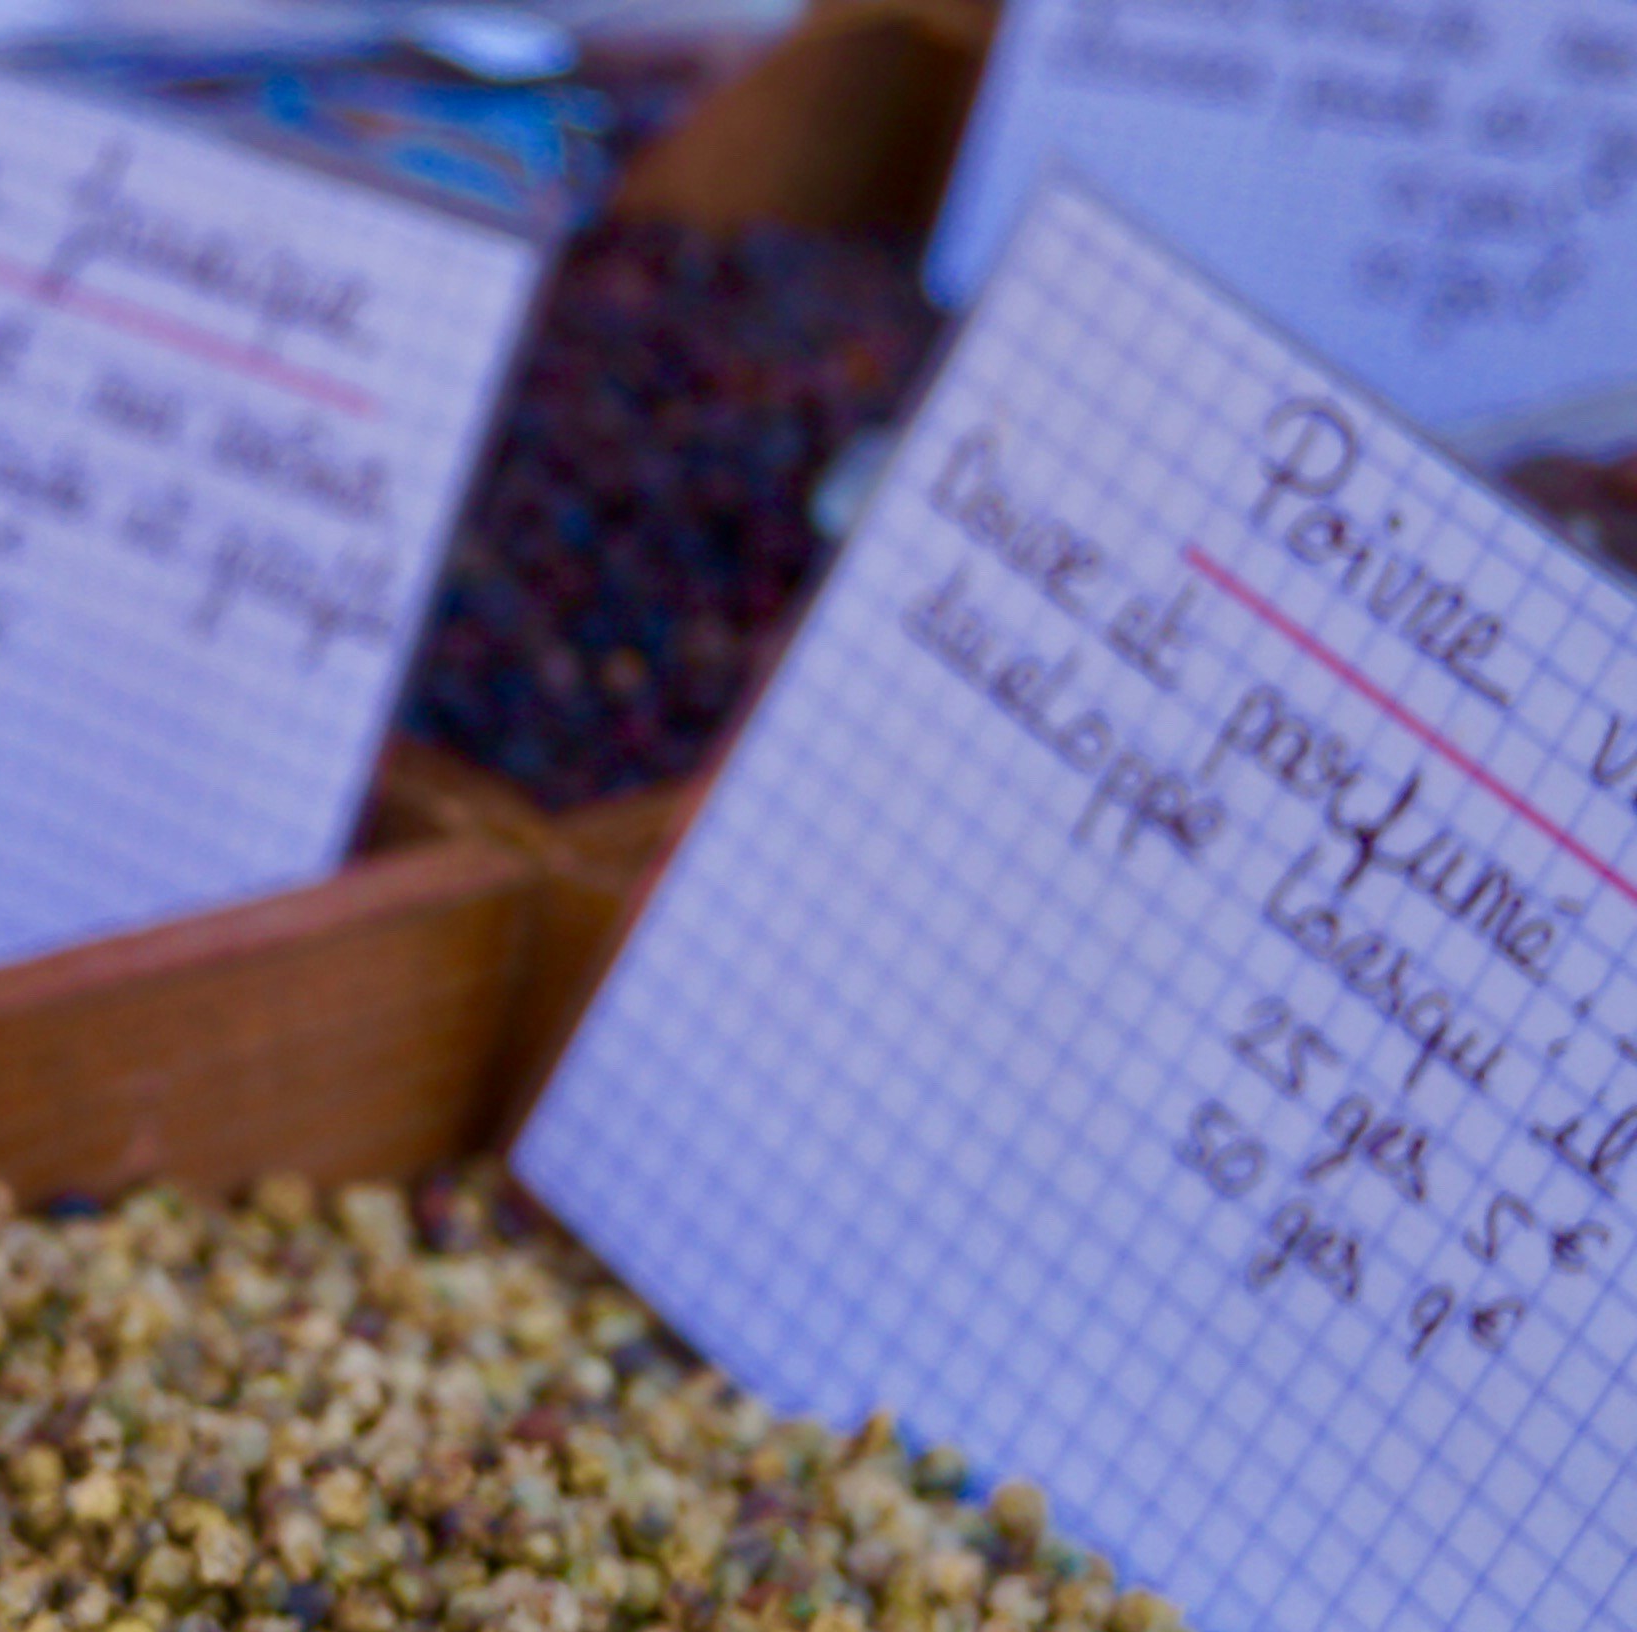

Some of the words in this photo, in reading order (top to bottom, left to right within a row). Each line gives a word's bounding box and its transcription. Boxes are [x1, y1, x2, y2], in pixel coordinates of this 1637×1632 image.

[1248, 397, 1511, 708] Poivre
[1106, 580, 1198, 692] et
[1232, 997, 1343, 1097] 25
[1172, 1102, 1269, 1200] 50
